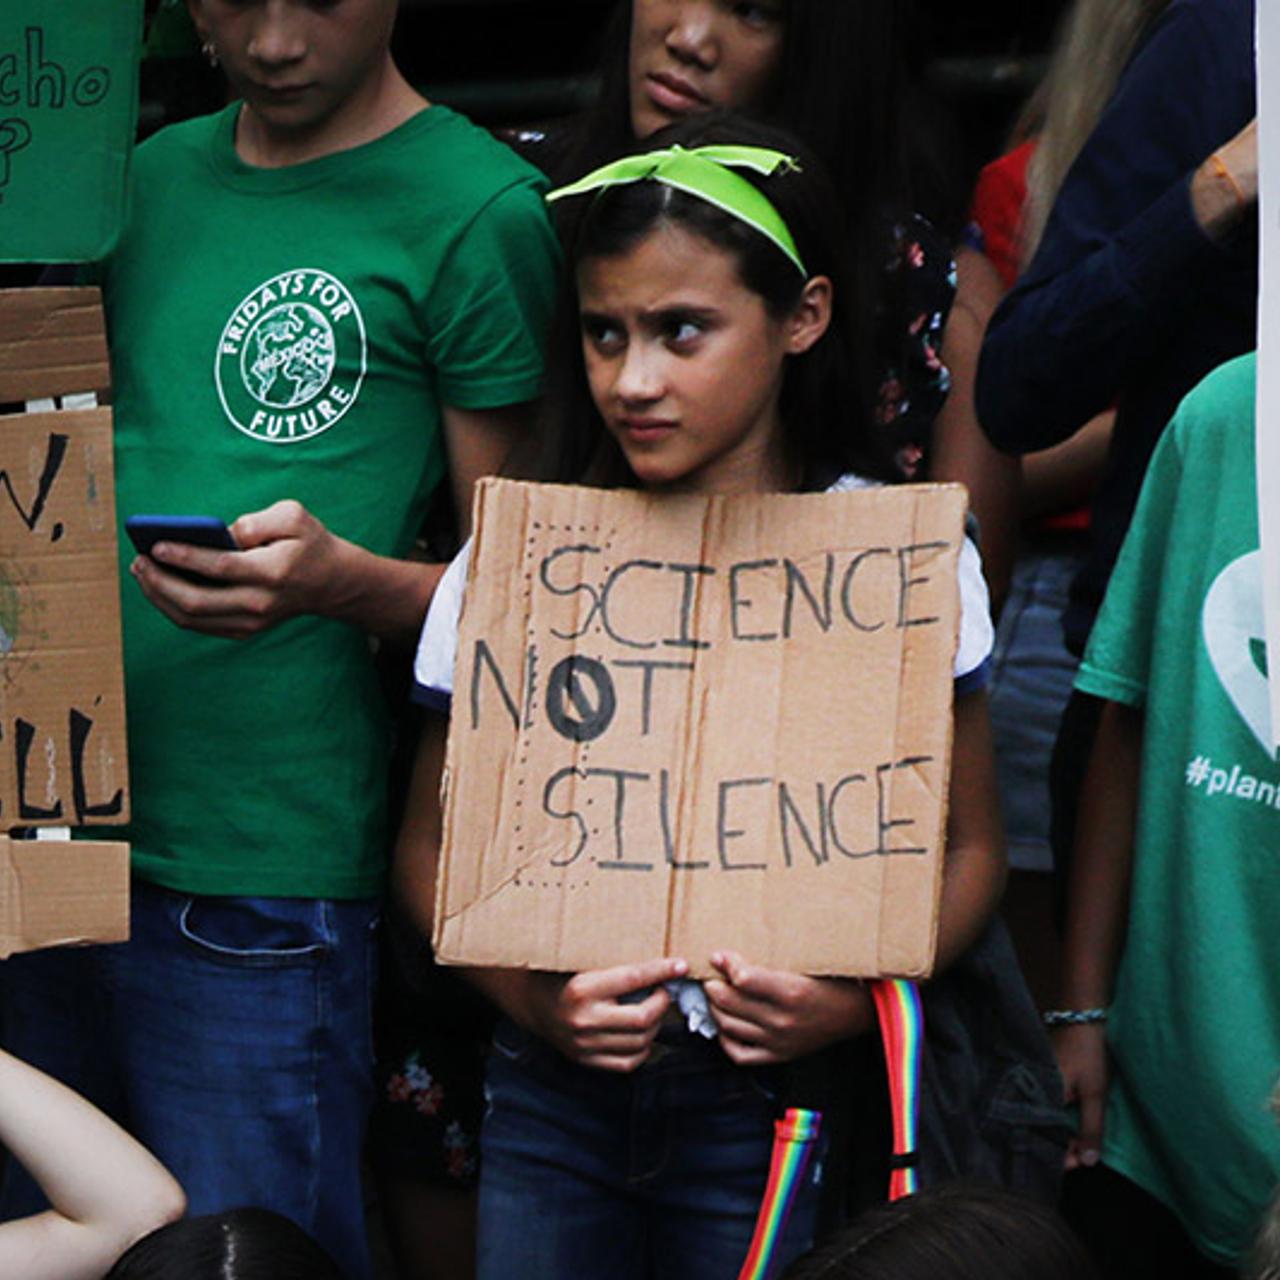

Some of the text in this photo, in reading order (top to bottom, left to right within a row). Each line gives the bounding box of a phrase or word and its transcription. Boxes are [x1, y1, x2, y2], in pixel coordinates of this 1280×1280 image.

[223, 274, 353, 354] FRIDAYS FOR
[249, 384, 351, 438] FUTURE
[541, 542, 950, 650] SCIENCE
[542, 757, 934, 872] SILENCE
